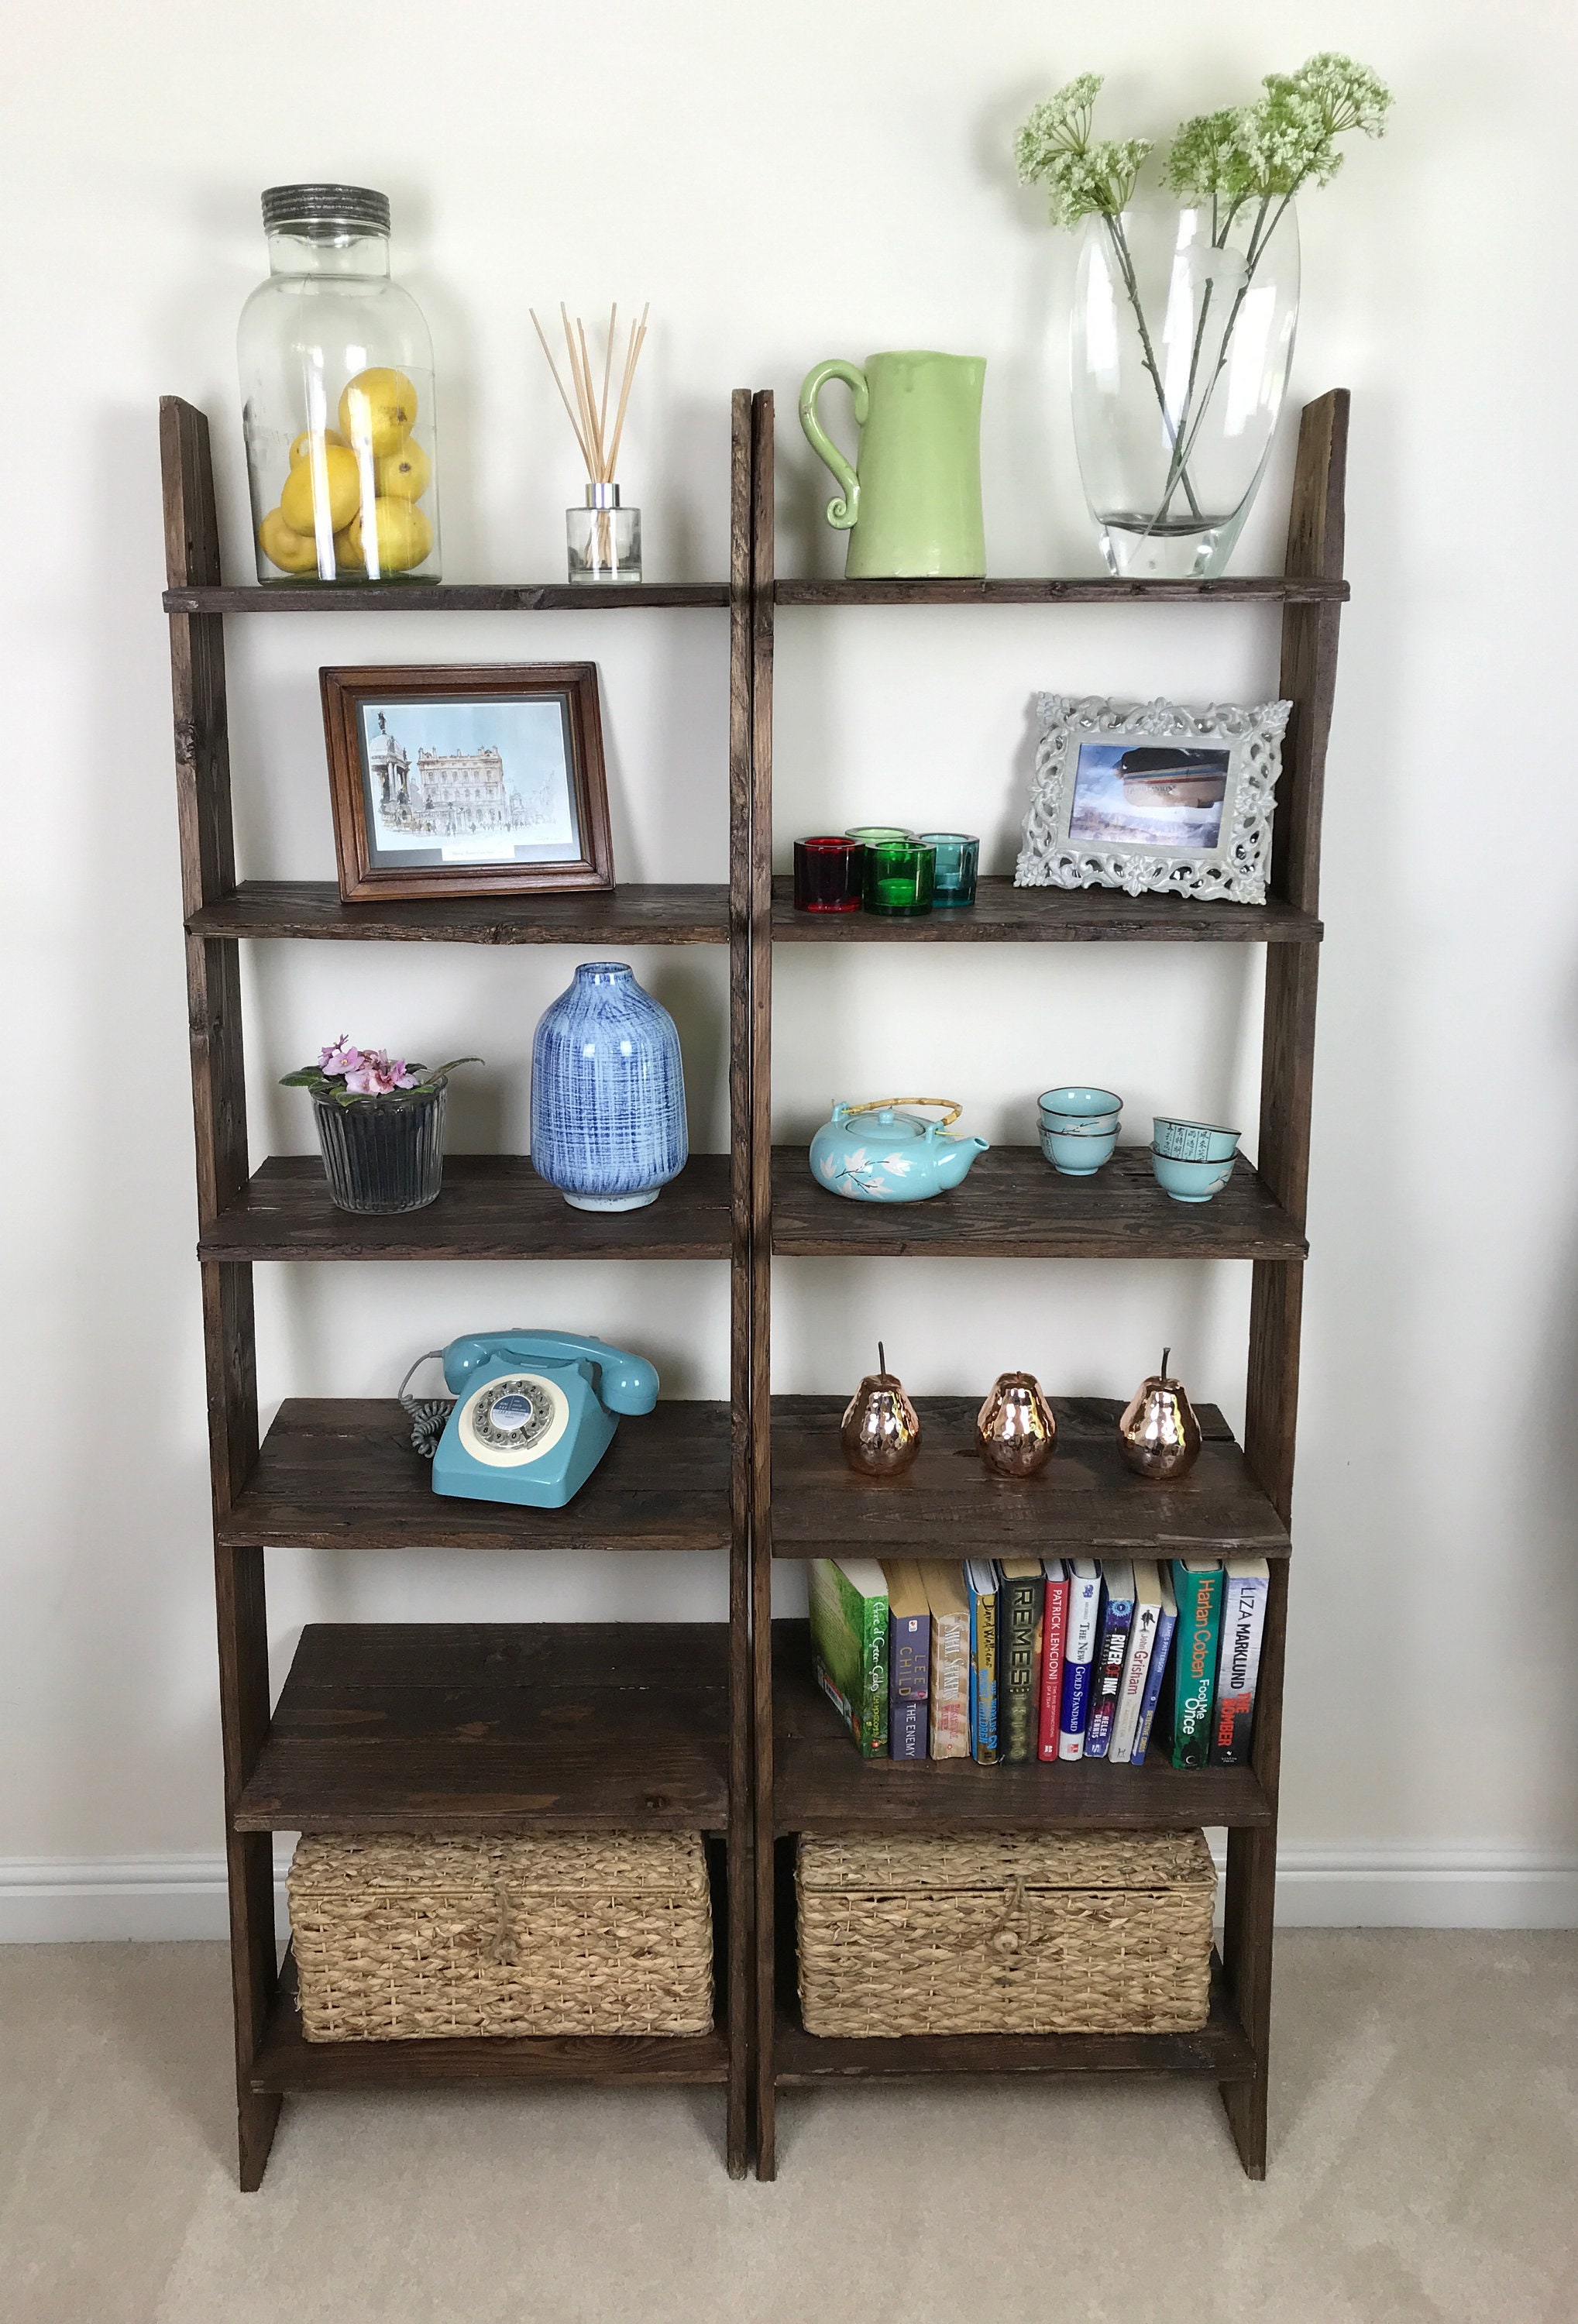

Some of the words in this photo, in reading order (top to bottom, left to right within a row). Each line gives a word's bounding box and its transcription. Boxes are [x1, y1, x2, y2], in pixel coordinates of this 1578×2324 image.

[1050, 1590, 1062, 1630] PATRICK
[1195, 1580, 1215, 1628] Harlan
[1238, 1587, 1257, 1621] LIZA
[1009, 1589, 1033, 1686] REMES
[1078, 1622, 1090, 1640] THE
[1140, 1633, 1148, 1650] John
[1163, 1622, 1173, 1642] JAMES
[1049, 1633, 1060, 1679] LENCIONI
[1077, 1642, 1088, 1662] NEW
[1107, 1634, 1126, 1665] RIVER
[1157, 1642, 1169, 1673] PATTERSON
[1191, 1630, 1212, 1679] Coben
[1230, 1624, 1251, 1690] MARKLUND
[899, 1647, 913, 1696] CHILD
[914, 1655, 926, 1684] LEE
[1074, 1666, 1085, 1690] GOLD
[1105, 1664, 1120, 1678] OF
[1127, 1650, 1149, 1695] Grisham
[1102, 1677, 1118, 1695] INK
[1198, 1679, 1210, 1702] Fool
[906, 1703, 916, 1722] THE
[1070, 1691, 1083, 1731] STANDARD
[1182, 1698, 1199, 1734] Once
[1196, 1703, 1208, 1720] Me
[1236, 1691, 1251, 1714] THE
[979, 1701, 988, 1743] CHILDREN
[1092, 1714, 1102, 1738] DENNIS
[1099, 1716, 1109, 1737] HELEN
[1218, 1697, 1237, 1747] BOMBER
[905, 1724, 916, 1757] ENEMY
